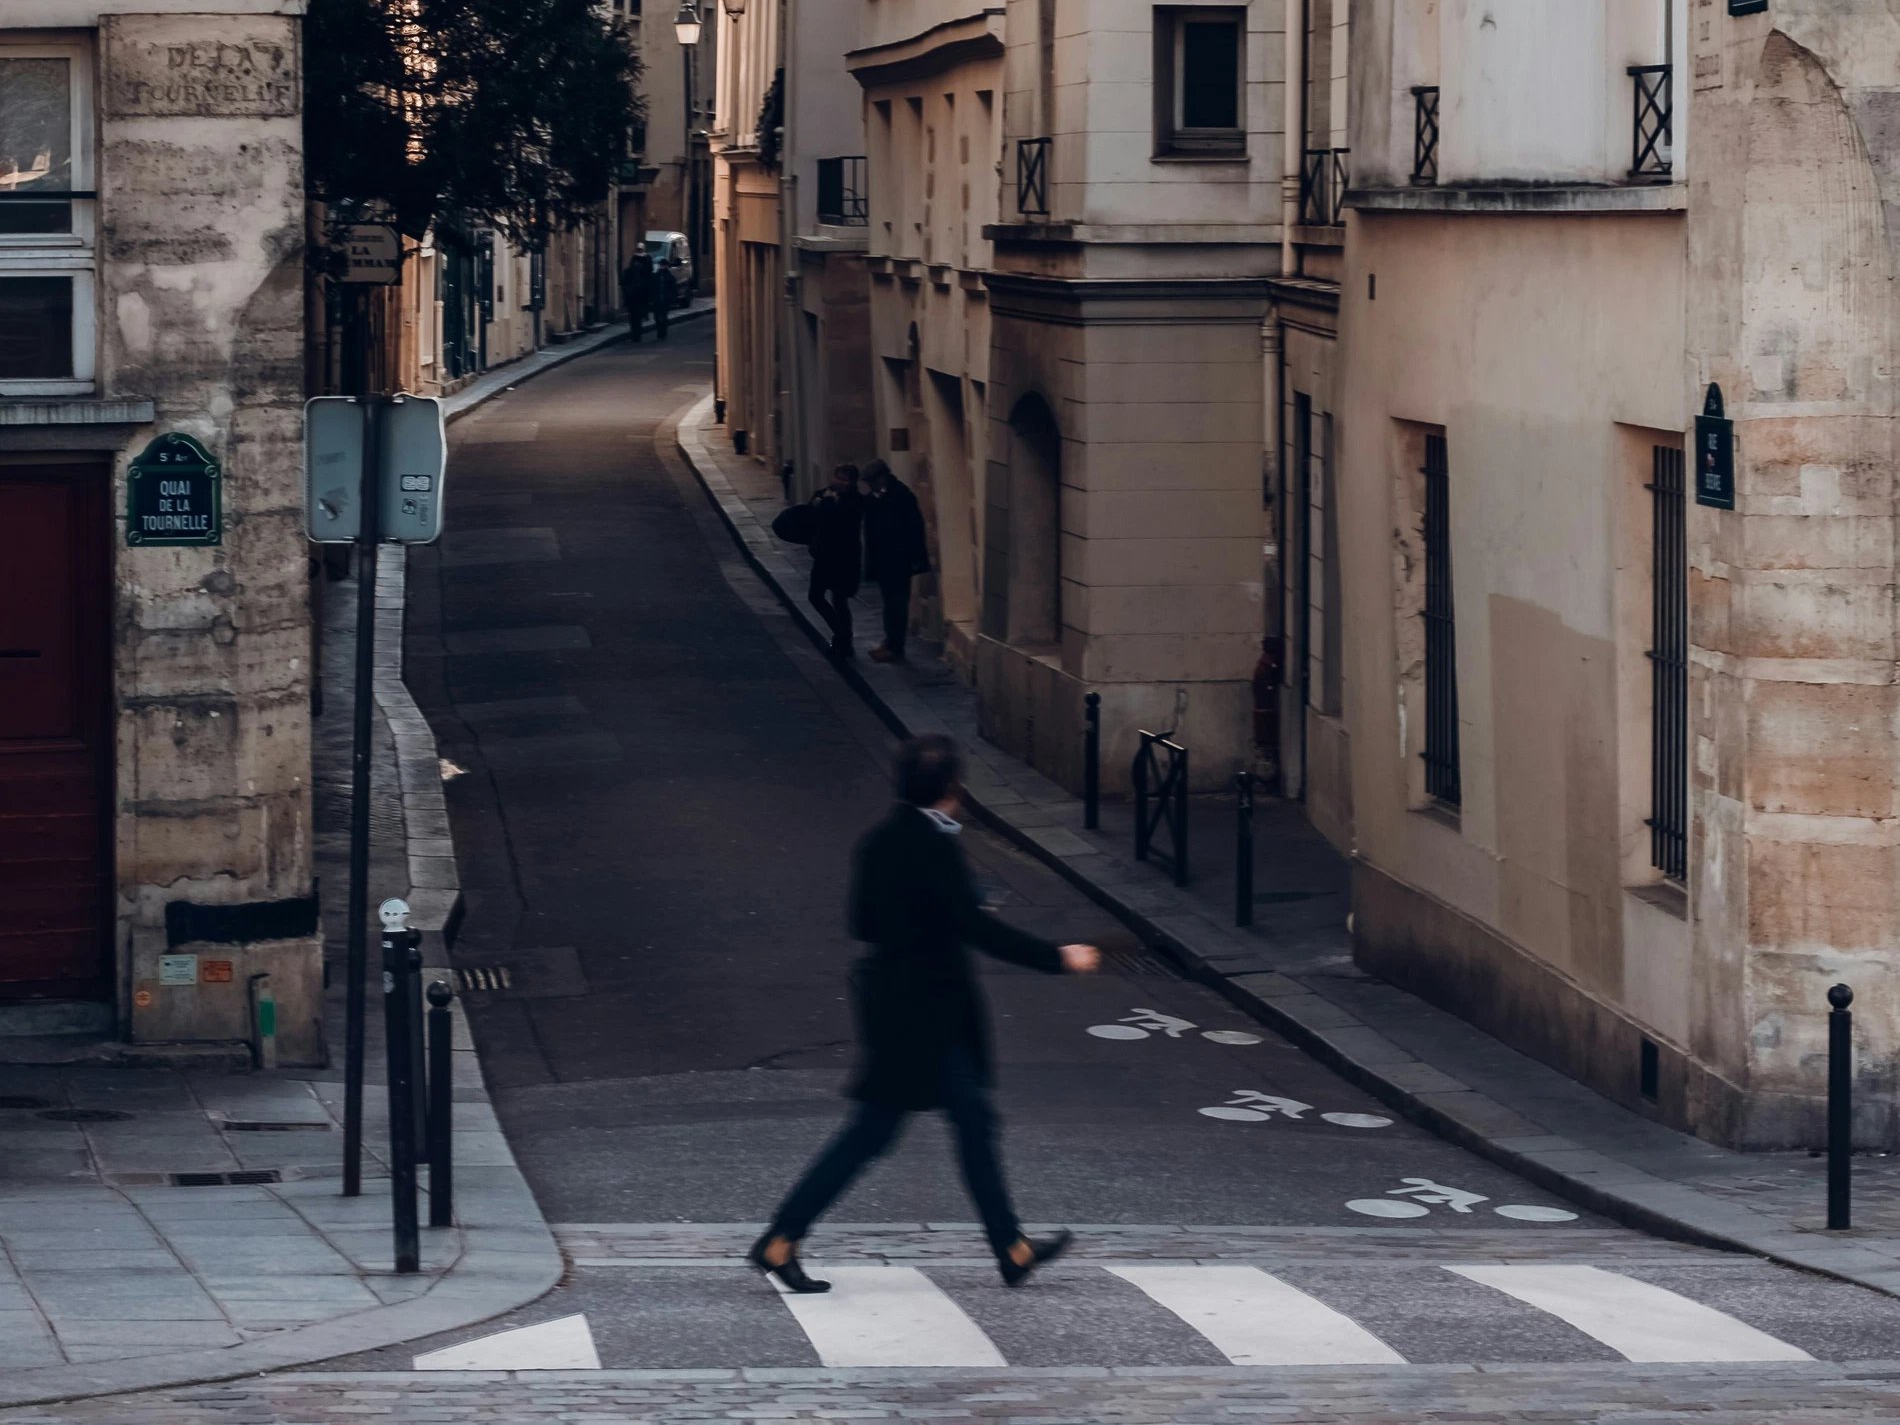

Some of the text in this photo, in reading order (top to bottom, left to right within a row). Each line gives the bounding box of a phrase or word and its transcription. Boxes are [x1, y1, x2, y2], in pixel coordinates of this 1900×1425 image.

[351, 246, 371, 256] LA
[160, 481, 190, 497] QUAI
[159, 499, 190, 512] DE LA
[142, 515, 208, 530] TOURNELLE
